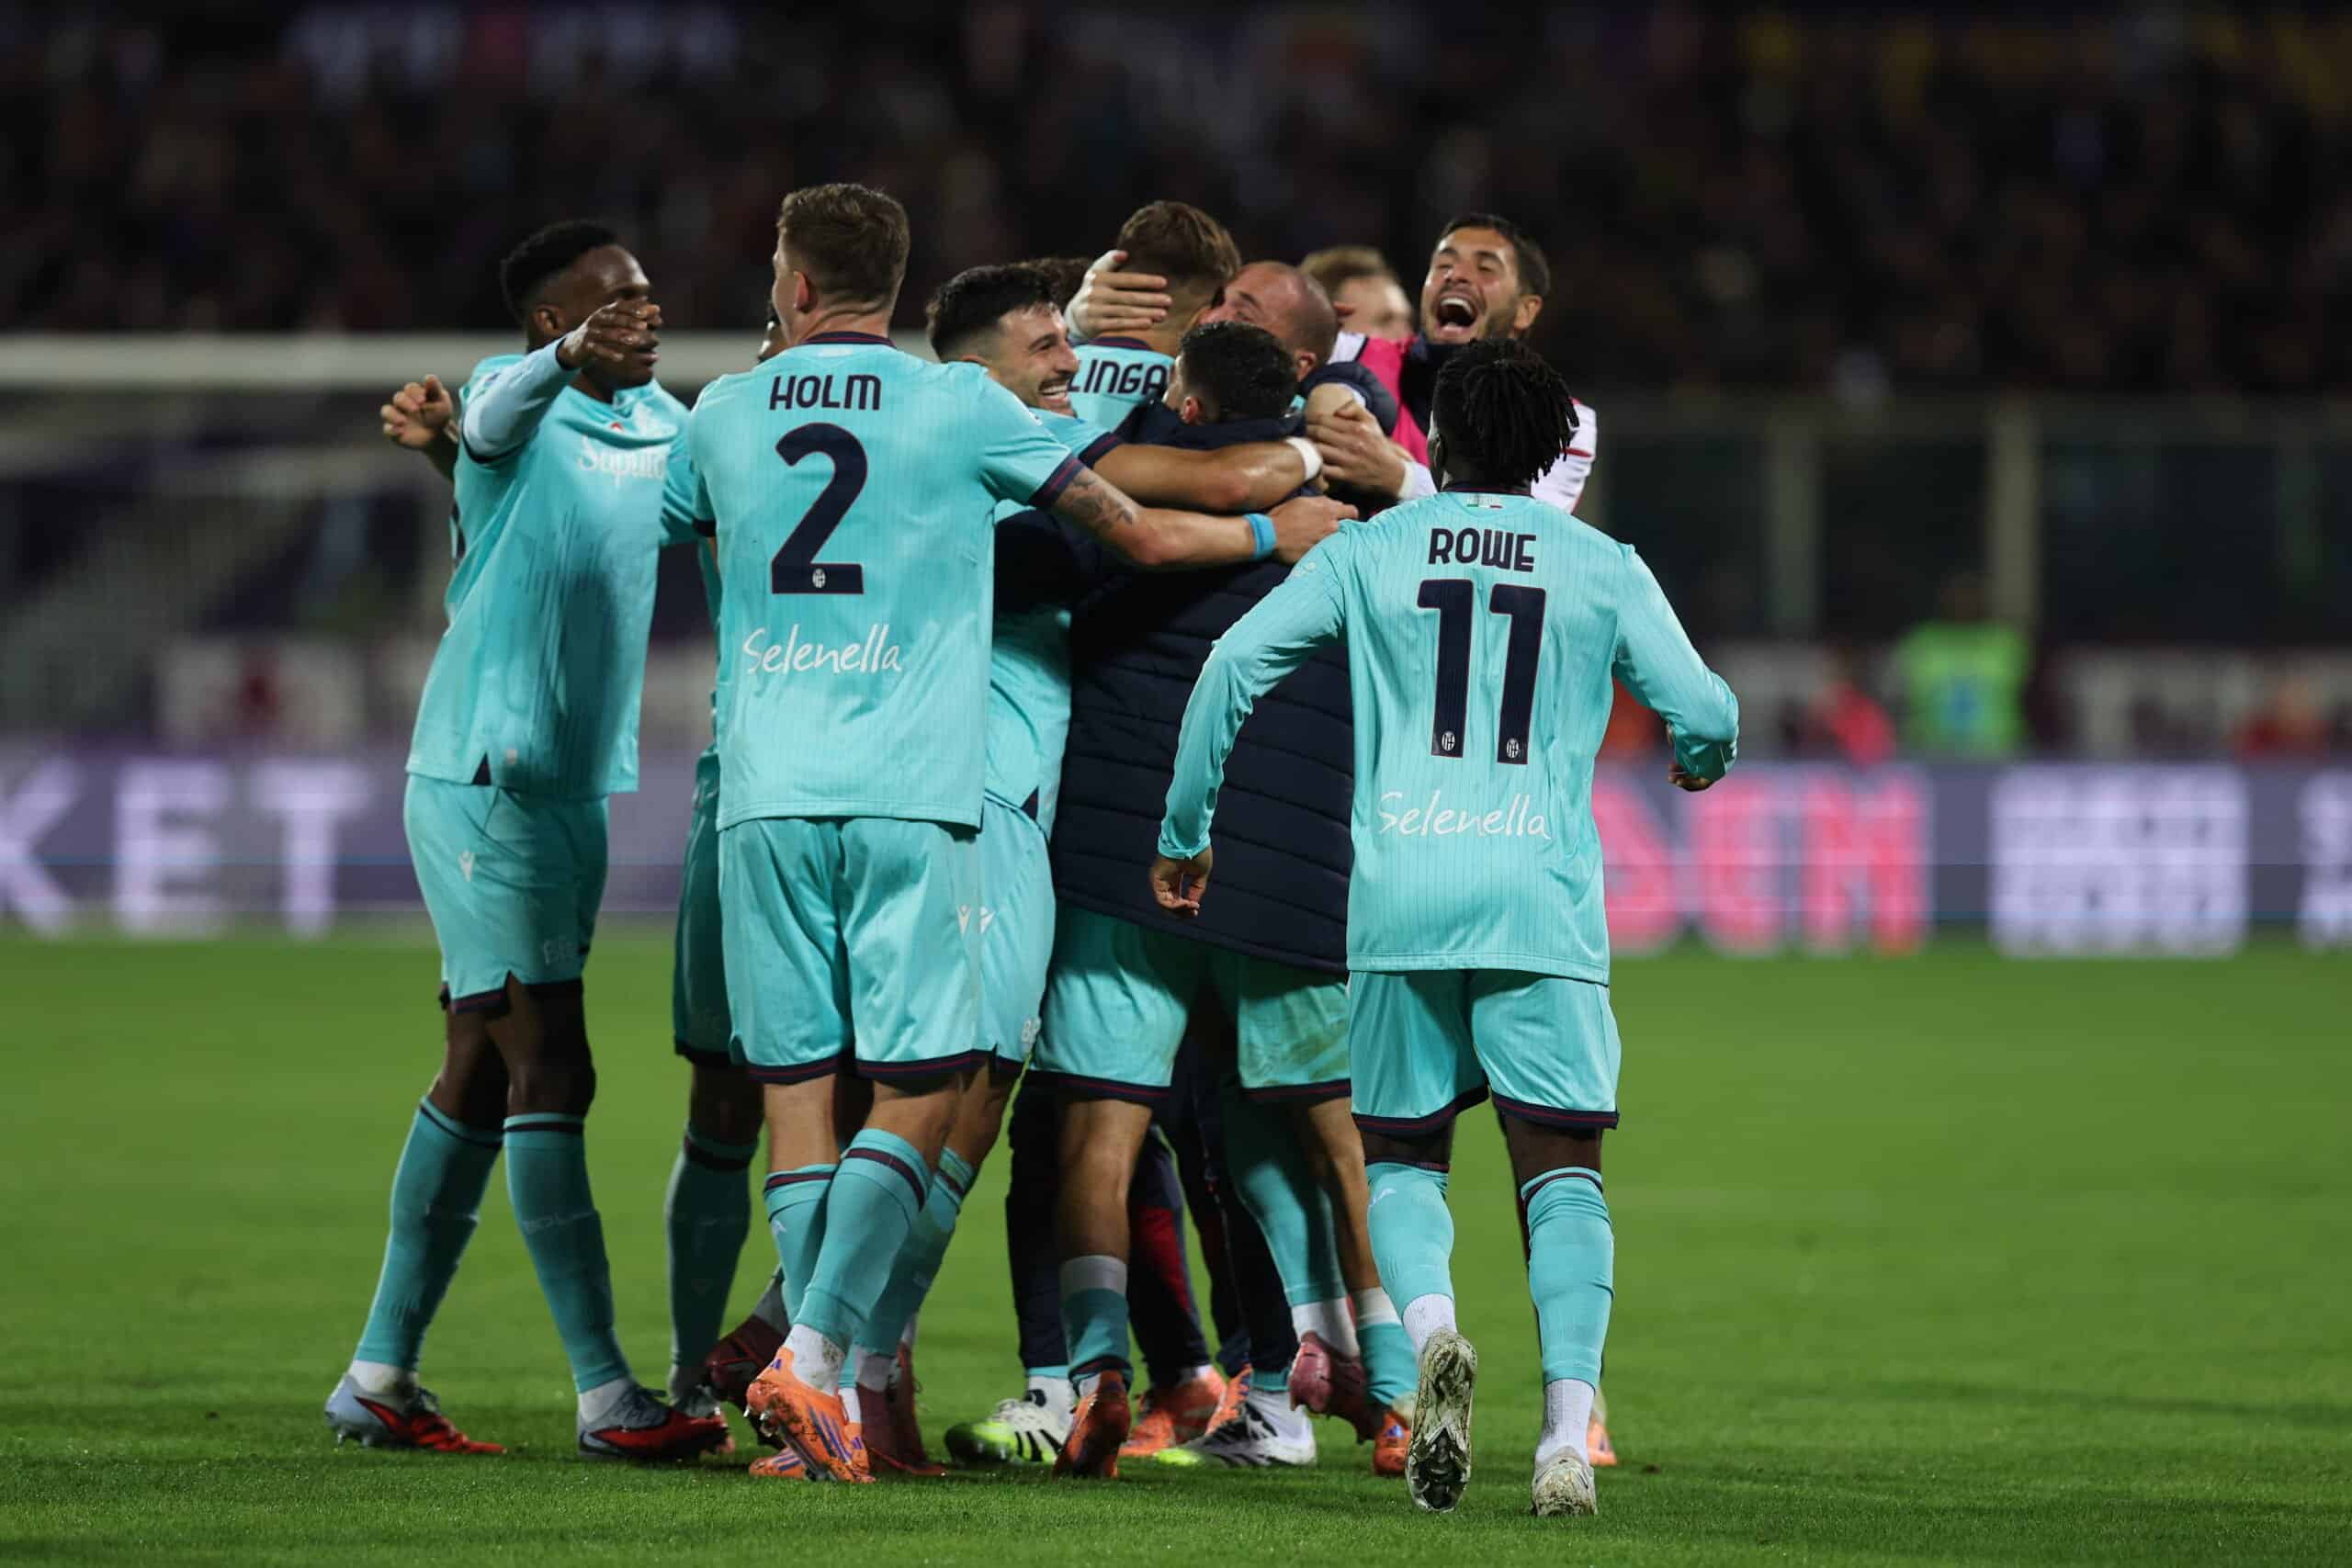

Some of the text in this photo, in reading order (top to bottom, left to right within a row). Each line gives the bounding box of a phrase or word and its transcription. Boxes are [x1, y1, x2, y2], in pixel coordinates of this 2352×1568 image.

[768, 374, 882, 411] HOLM
[772, 423, 868, 595] 2
[1428, 527, 1537, 572] ROWE
[743, 624, 903, 674] Selenella
[1417, 579, 1546, 765] 11
[1377, 789, 1552, 840] Selenella
